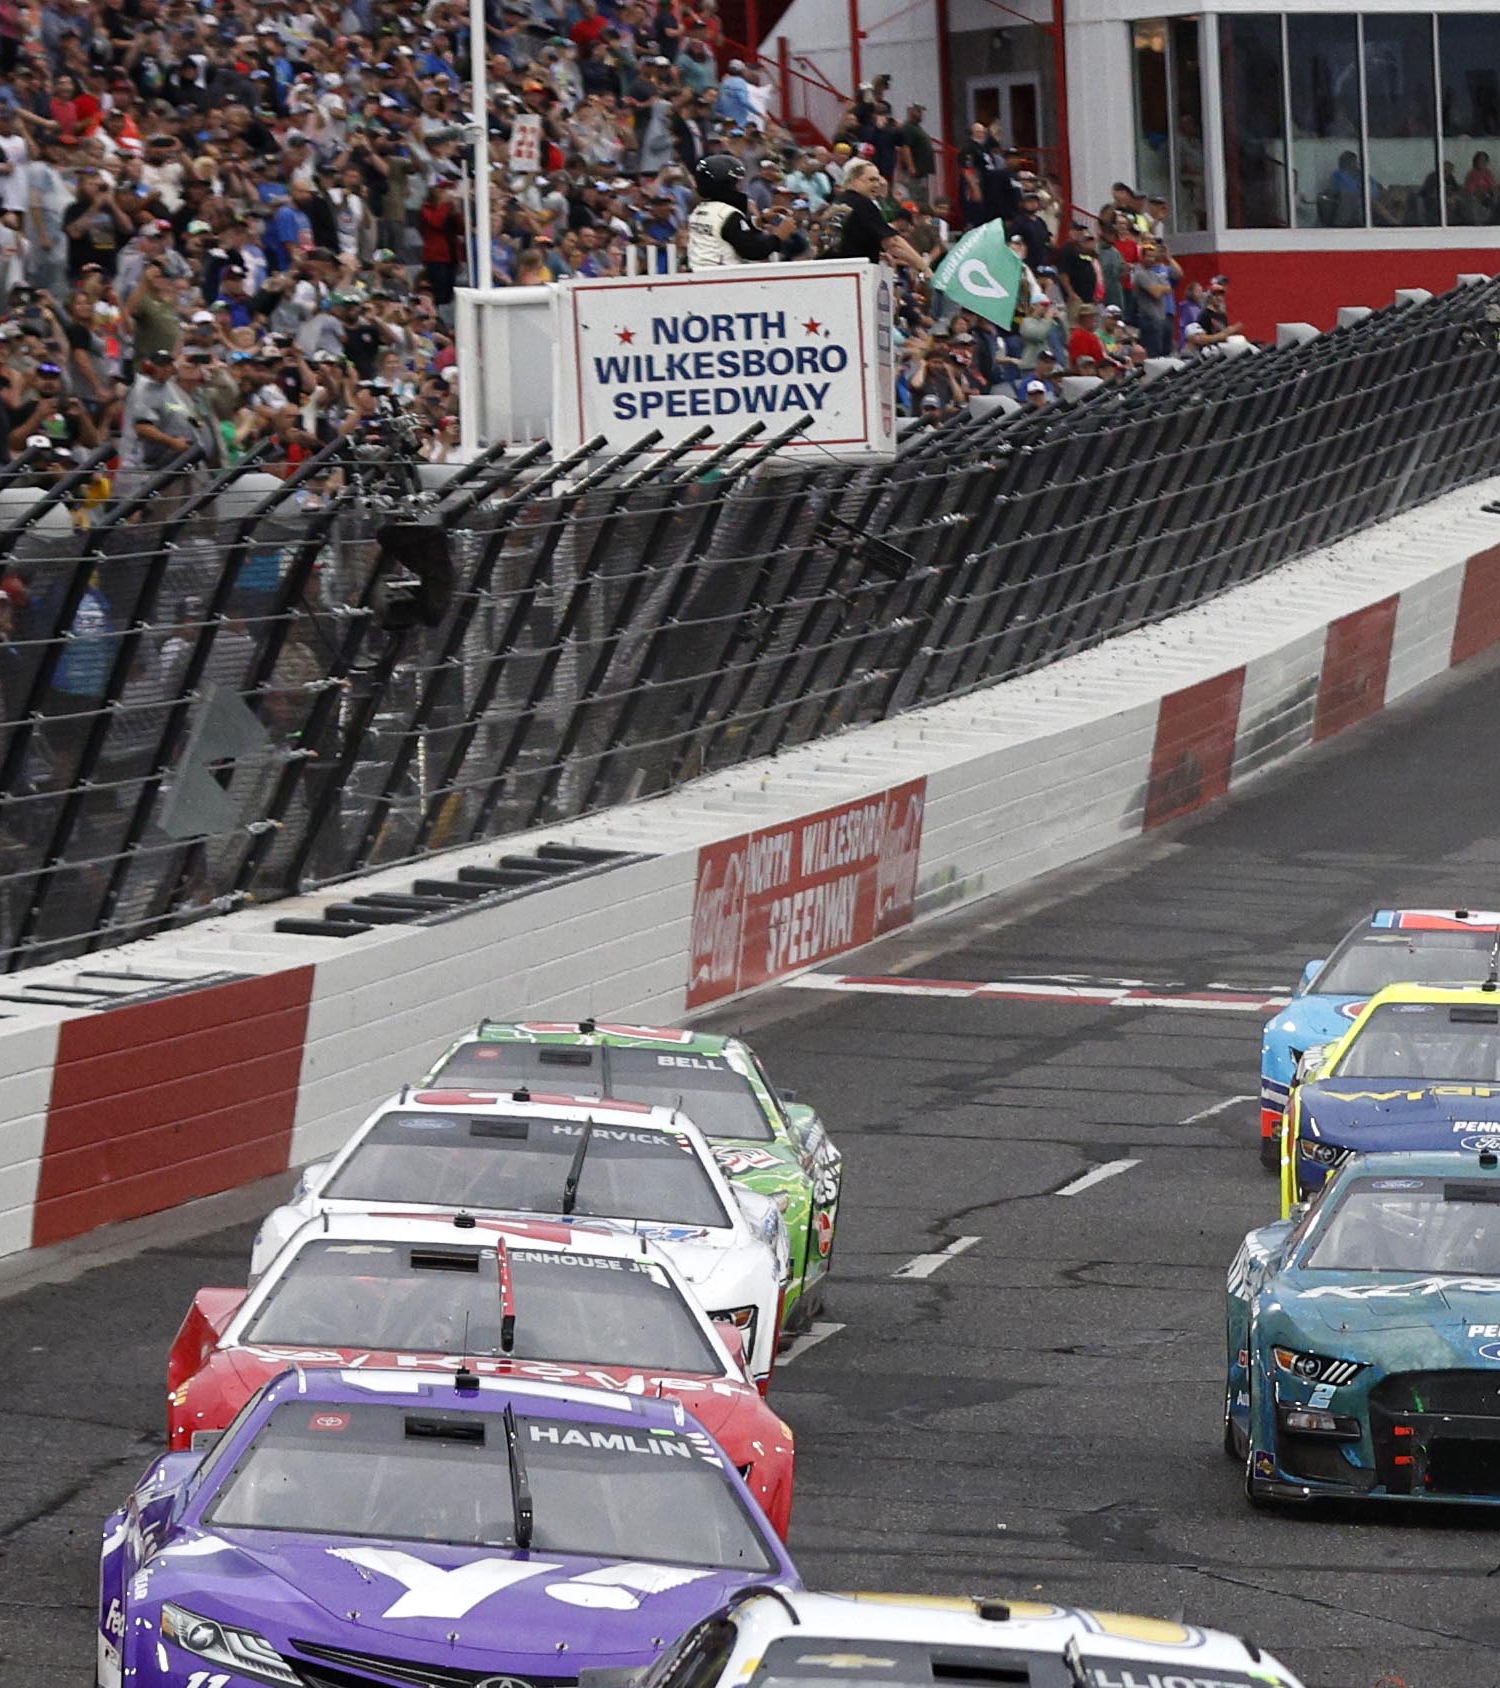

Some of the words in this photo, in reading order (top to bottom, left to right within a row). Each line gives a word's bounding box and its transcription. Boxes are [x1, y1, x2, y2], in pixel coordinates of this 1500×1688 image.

[651, 310, 787, 347] NORTH
[594, 344, 848, 386] WILKESBORO
[612, 381, 831, 420] SPEEDWAY
[747, 830, 794, 895] NORTH
[766, 873, 860, 974] SPEEDWAY
[656, 1055, 724, 1071] BELL
[480, 1249, 622, 1271] SENHOUSE
[1307, 1383, 1337, 1408] 2
[528, 1424, 692, 1459] HAMLIN
[106, 1598, 125, 1638] Fed
